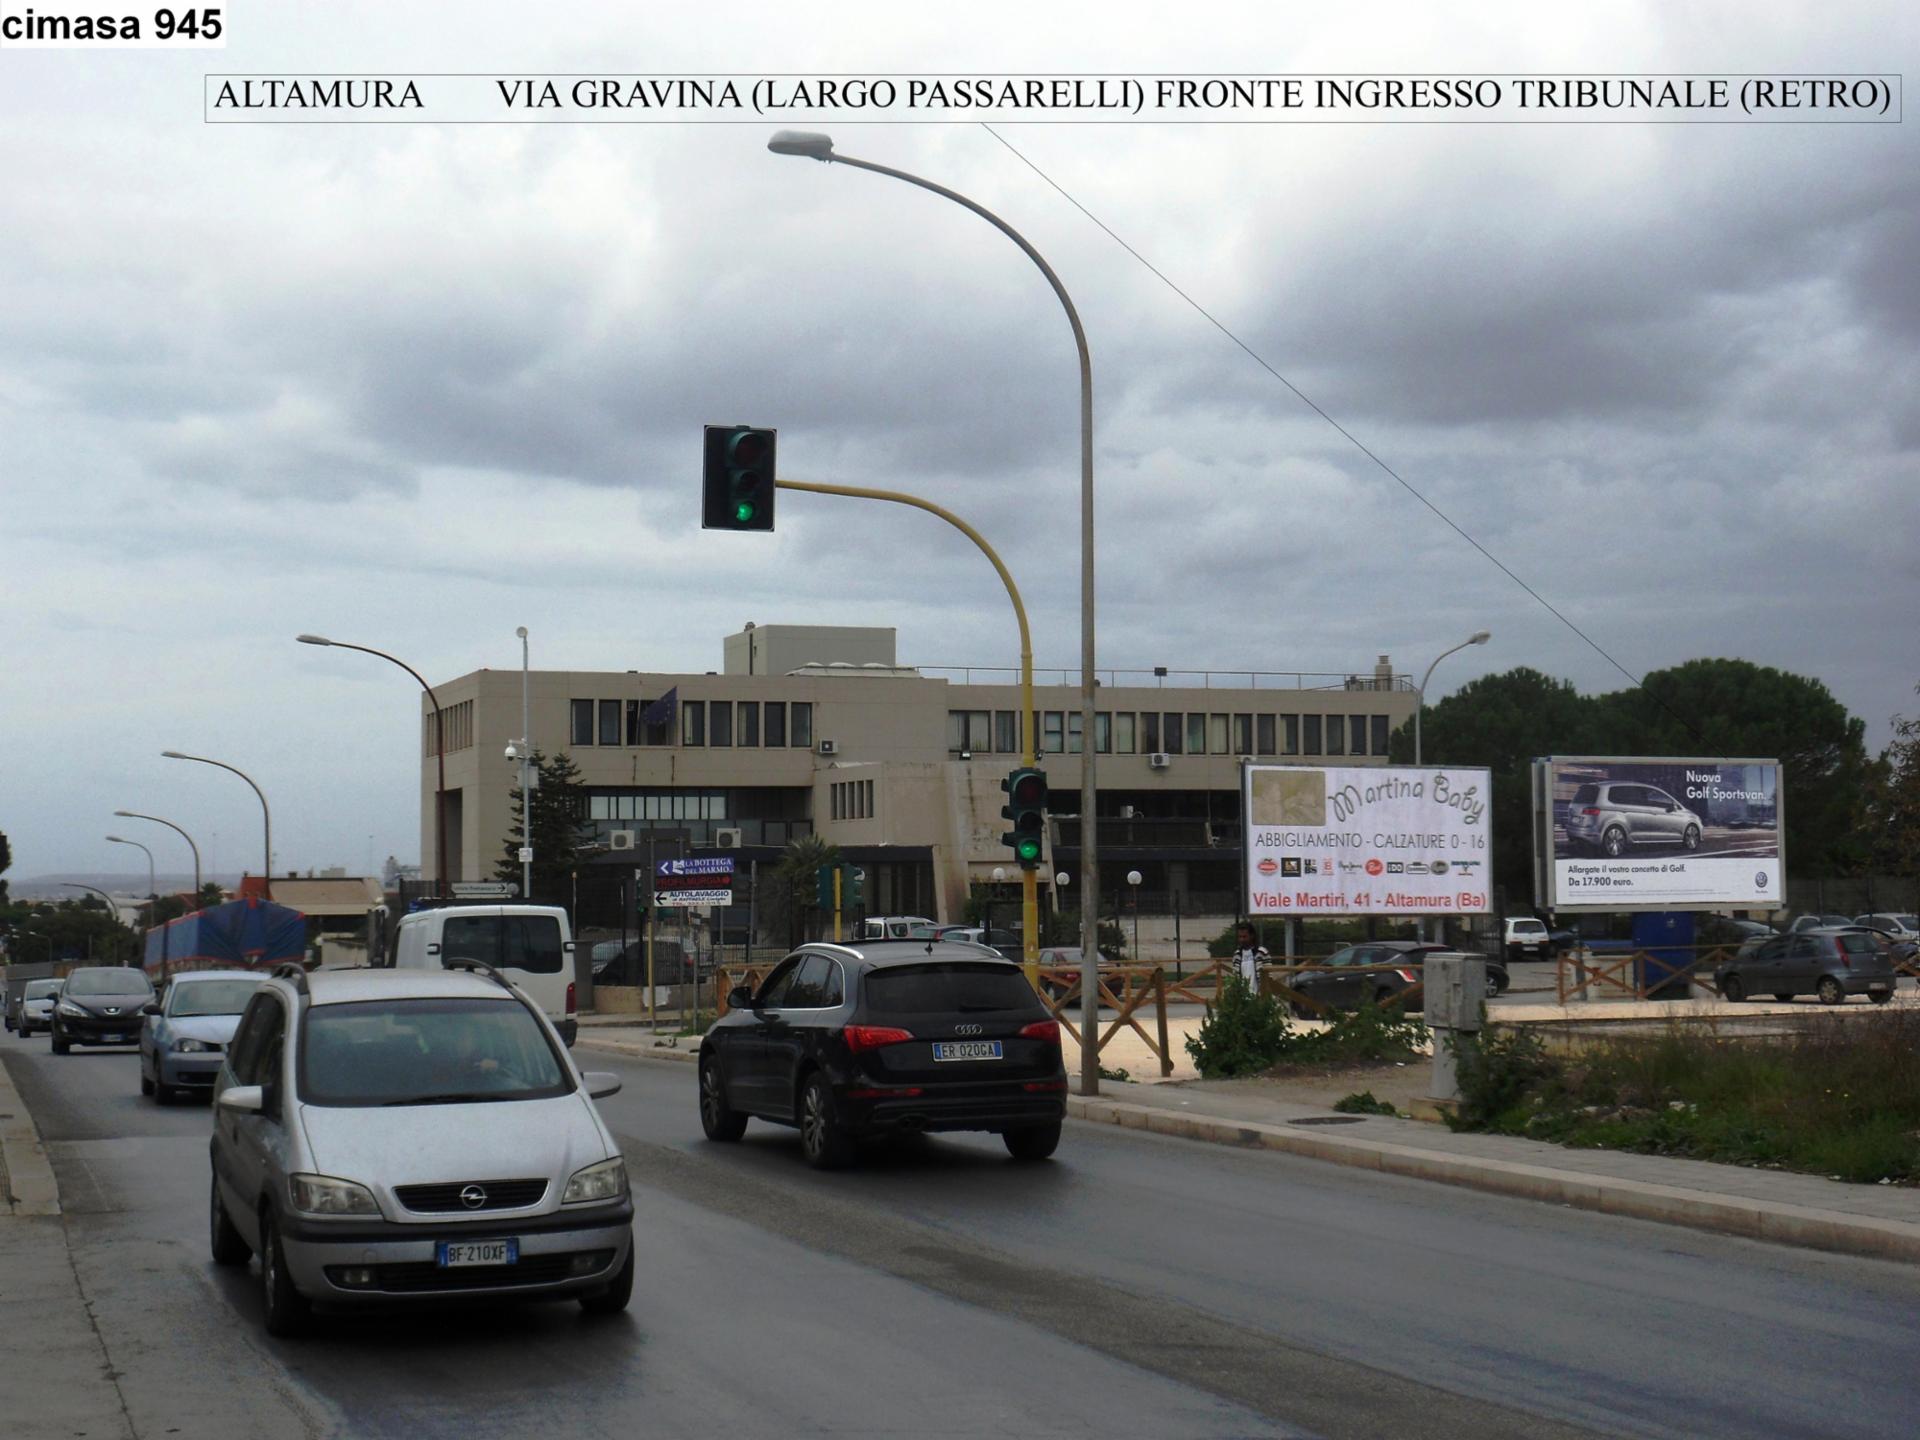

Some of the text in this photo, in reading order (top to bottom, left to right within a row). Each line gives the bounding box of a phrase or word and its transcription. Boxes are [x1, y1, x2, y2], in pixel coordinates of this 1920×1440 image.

[1685, 770, 1722, 783] Nuova
[1328, 771, 1485, 825] Martina Baby
[1686, 786, 1767, 802] Golf Sportsvan.
[1255, 832, 1363, 848] ABBIGLIAMENTO
[1374, 833, 1446, 849] CALZATURE
[1471, 834, 1485, 849] 16
[694, 858, 732, 866] BOTTEGA
[699, 866, 729, 874] MARMO
[1568, 865, 1600, 875] Allargate
[1601, 865, 1607, 873] il
[1608, 865, 1630, 873] vostro
[1631, 865, 1660, 873] concetto
[1661, 864, 1668, 873] di
[1568, 877, 1580, 886] Da
[1582, 877, 1612, 886] 17.900
[1253, 893, 1291, 907] Viale
[1296, 893, 1349, 909] Martiri,
[1354, 893, 1371, 907] 41
[1384, 893, 1452, 907] Altamura
[1455, 892, 1487, 909] (Ba)
[942, 1044, 995, 1057] ER 020GA
[448, 1245, 506, 1262] BF 210XF
